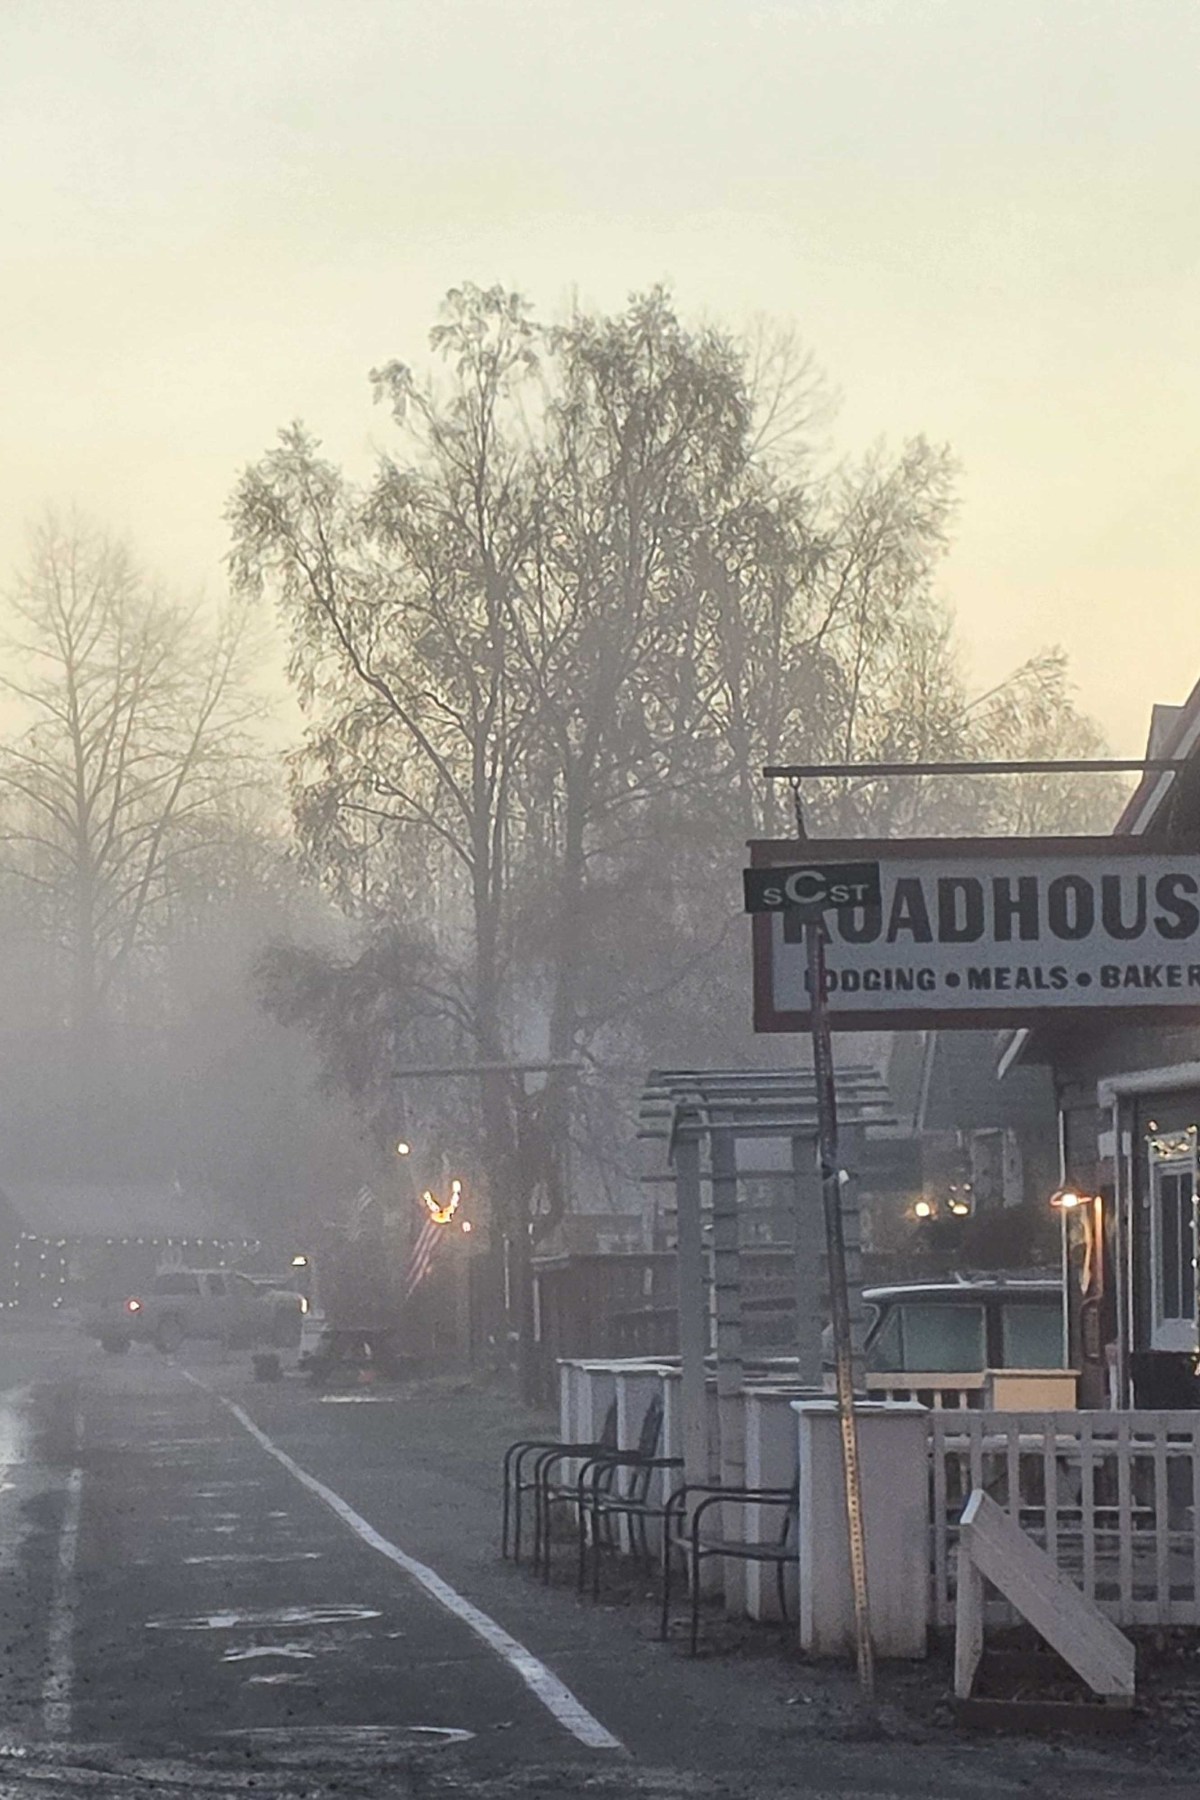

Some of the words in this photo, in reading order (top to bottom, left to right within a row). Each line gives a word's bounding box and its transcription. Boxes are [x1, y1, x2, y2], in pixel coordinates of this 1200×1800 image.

[804, 967, 936, 993] ODGING
[967, 966, 1068, 990] MEALS
[1100, 964, 1200, 988] BAKER
